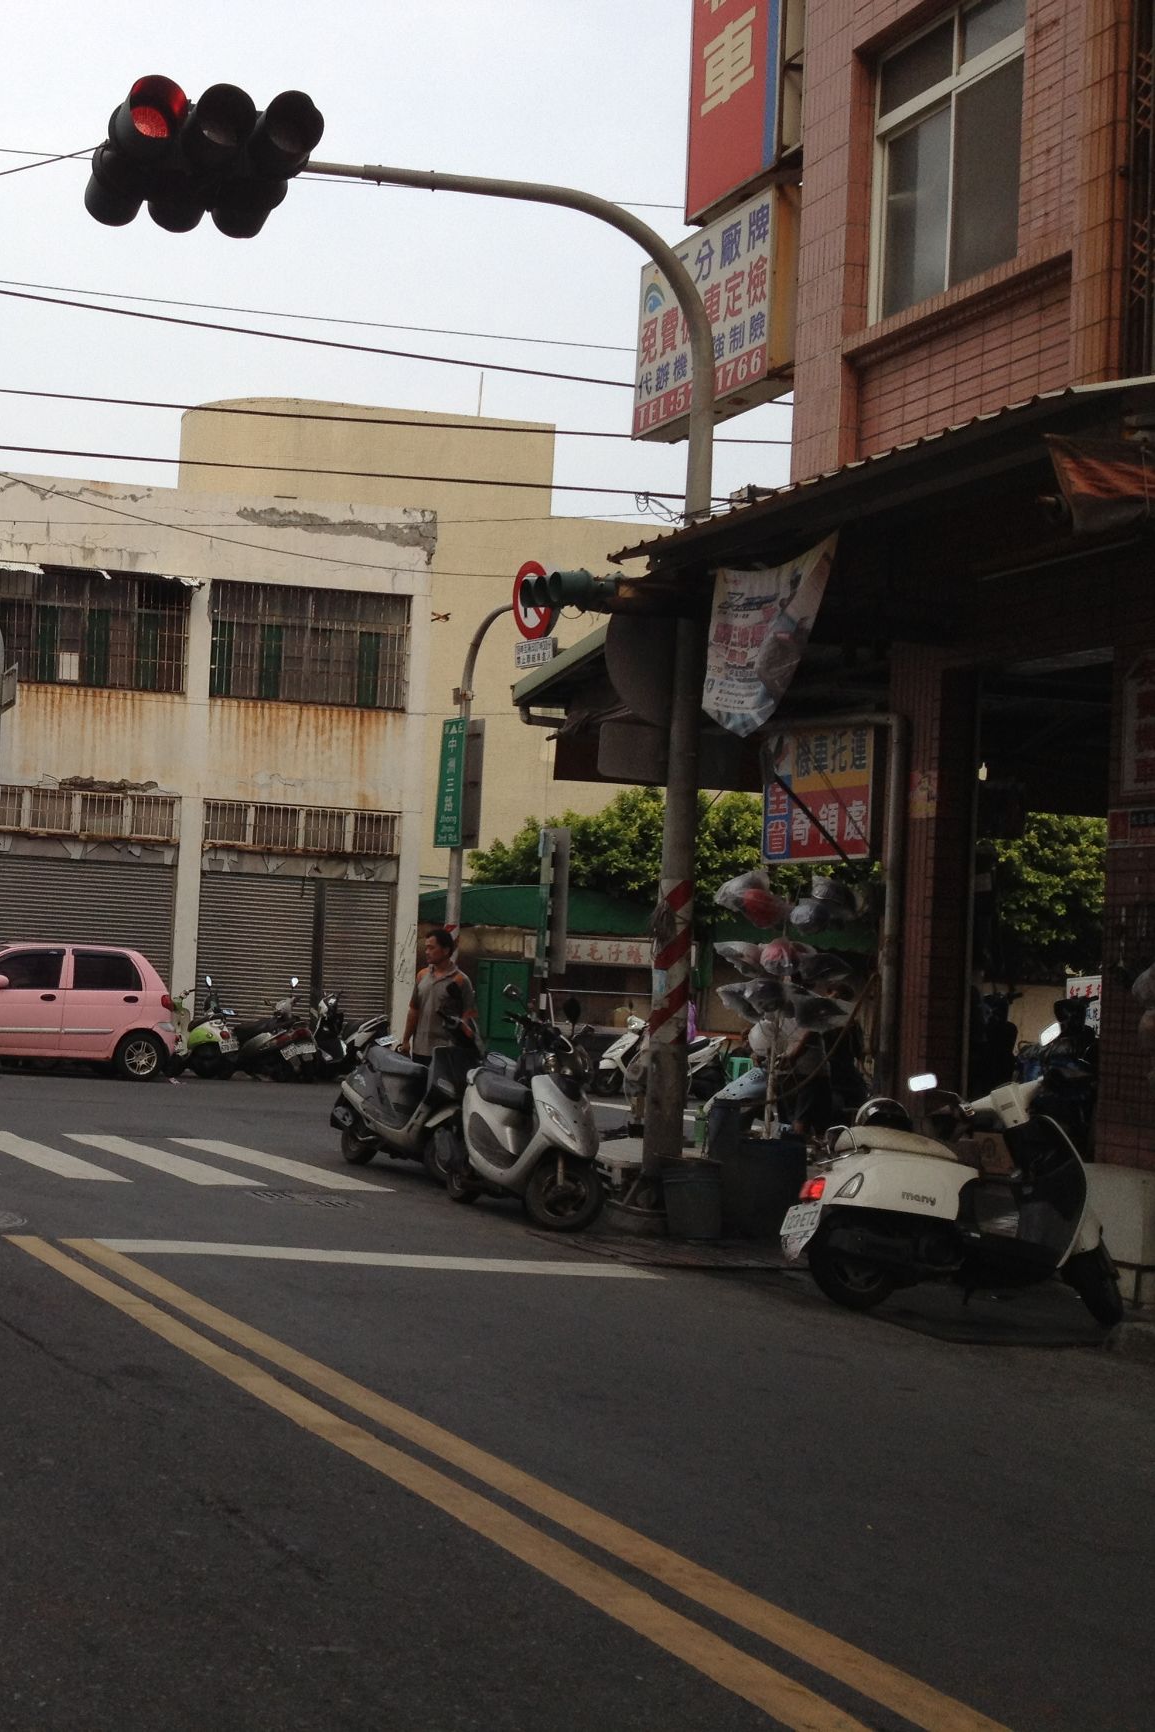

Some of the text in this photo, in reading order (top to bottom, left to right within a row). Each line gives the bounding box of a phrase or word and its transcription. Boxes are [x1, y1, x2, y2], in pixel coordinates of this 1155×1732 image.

[700, 0, 757, 117] 車
[679, 203, 770, 283] 分廠牌
[638, 311, 766, 399] 代辦機強制險
[901, 1191, 937, 1207] many
